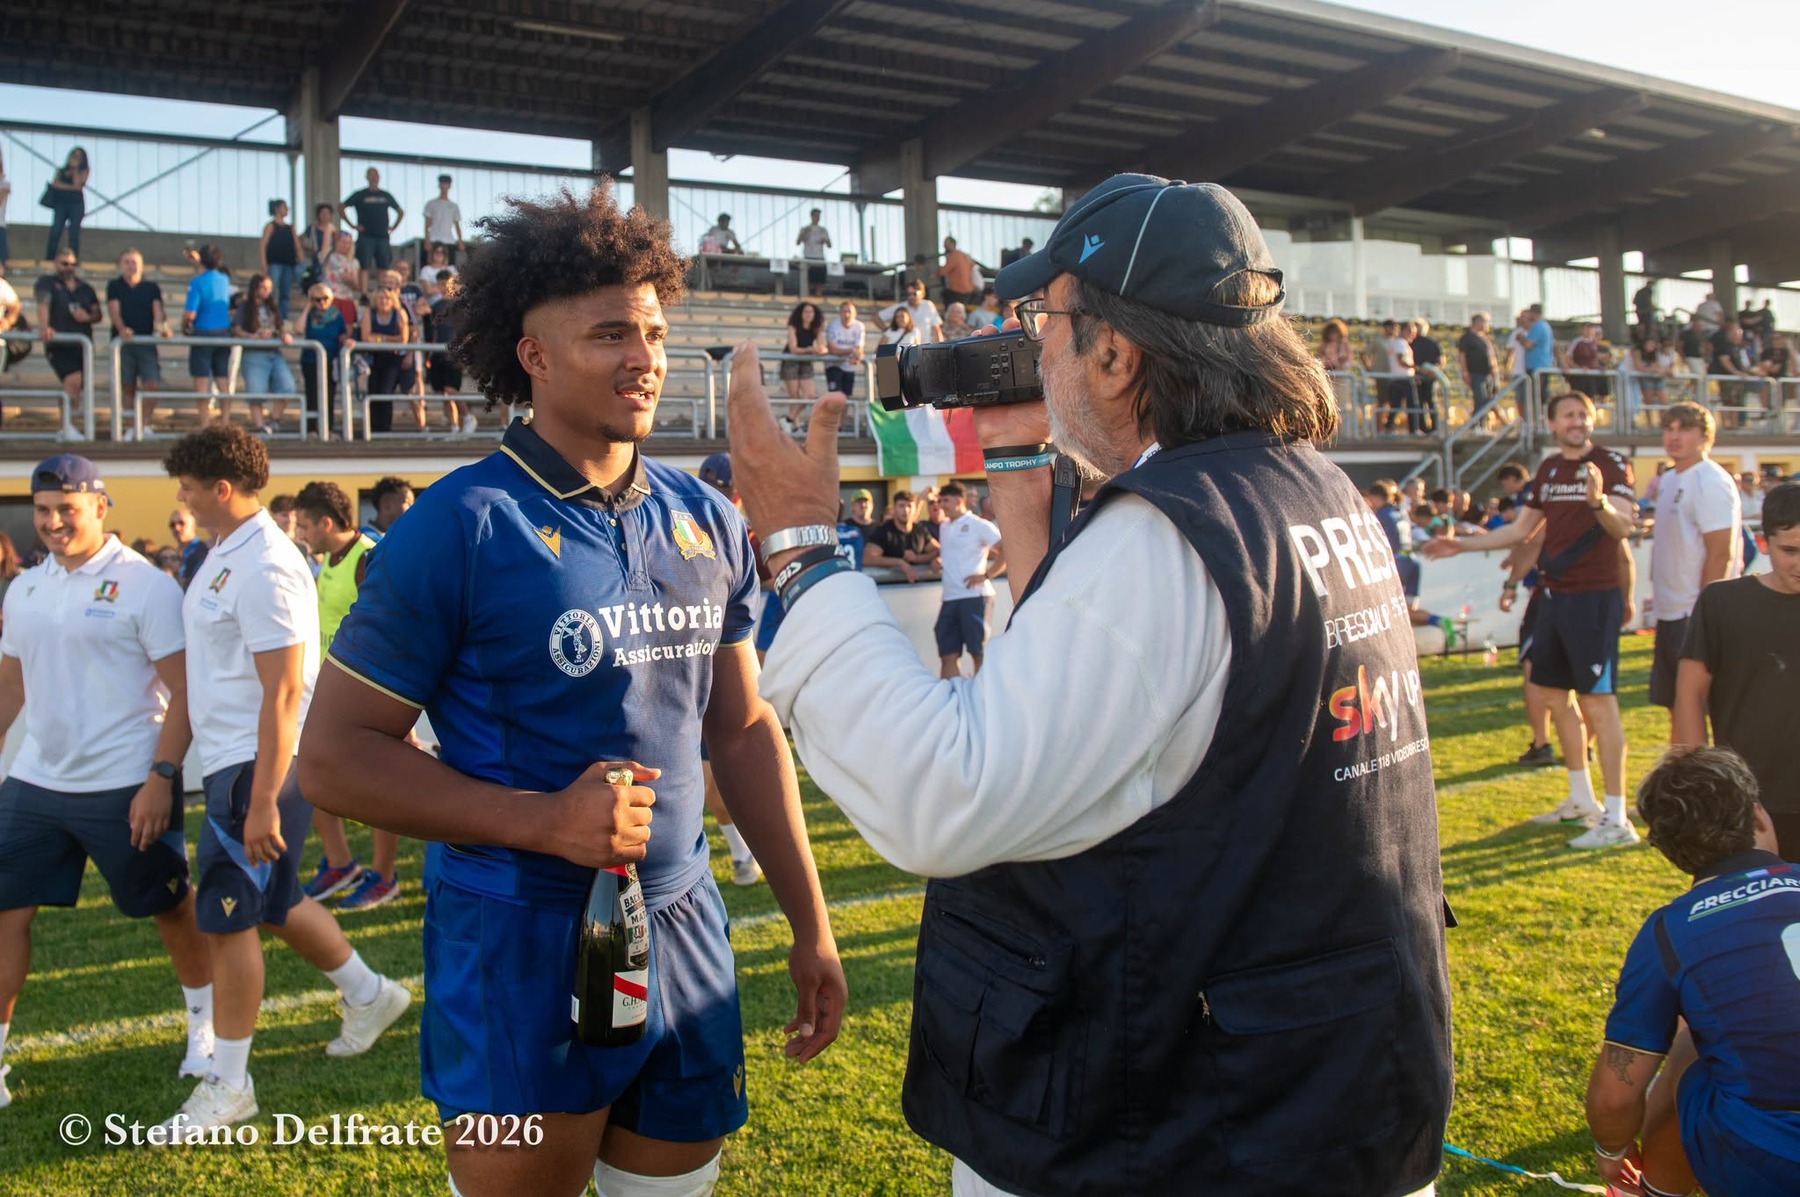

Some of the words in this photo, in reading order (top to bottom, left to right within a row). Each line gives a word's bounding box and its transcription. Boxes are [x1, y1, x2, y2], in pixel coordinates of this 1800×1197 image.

[1005, 459, 1036, 468] TROPHY
[554, 612, 595, 635] VITTORIA
[599, 597, 724, 638] Vittoria
[553, 640, 600, 674] ASSICURAZIONI
[1329, 664, 1398, 742] sky
[1334, 759, 1377, 782] CANALE
[1378, 753, 1390, 769] 118
